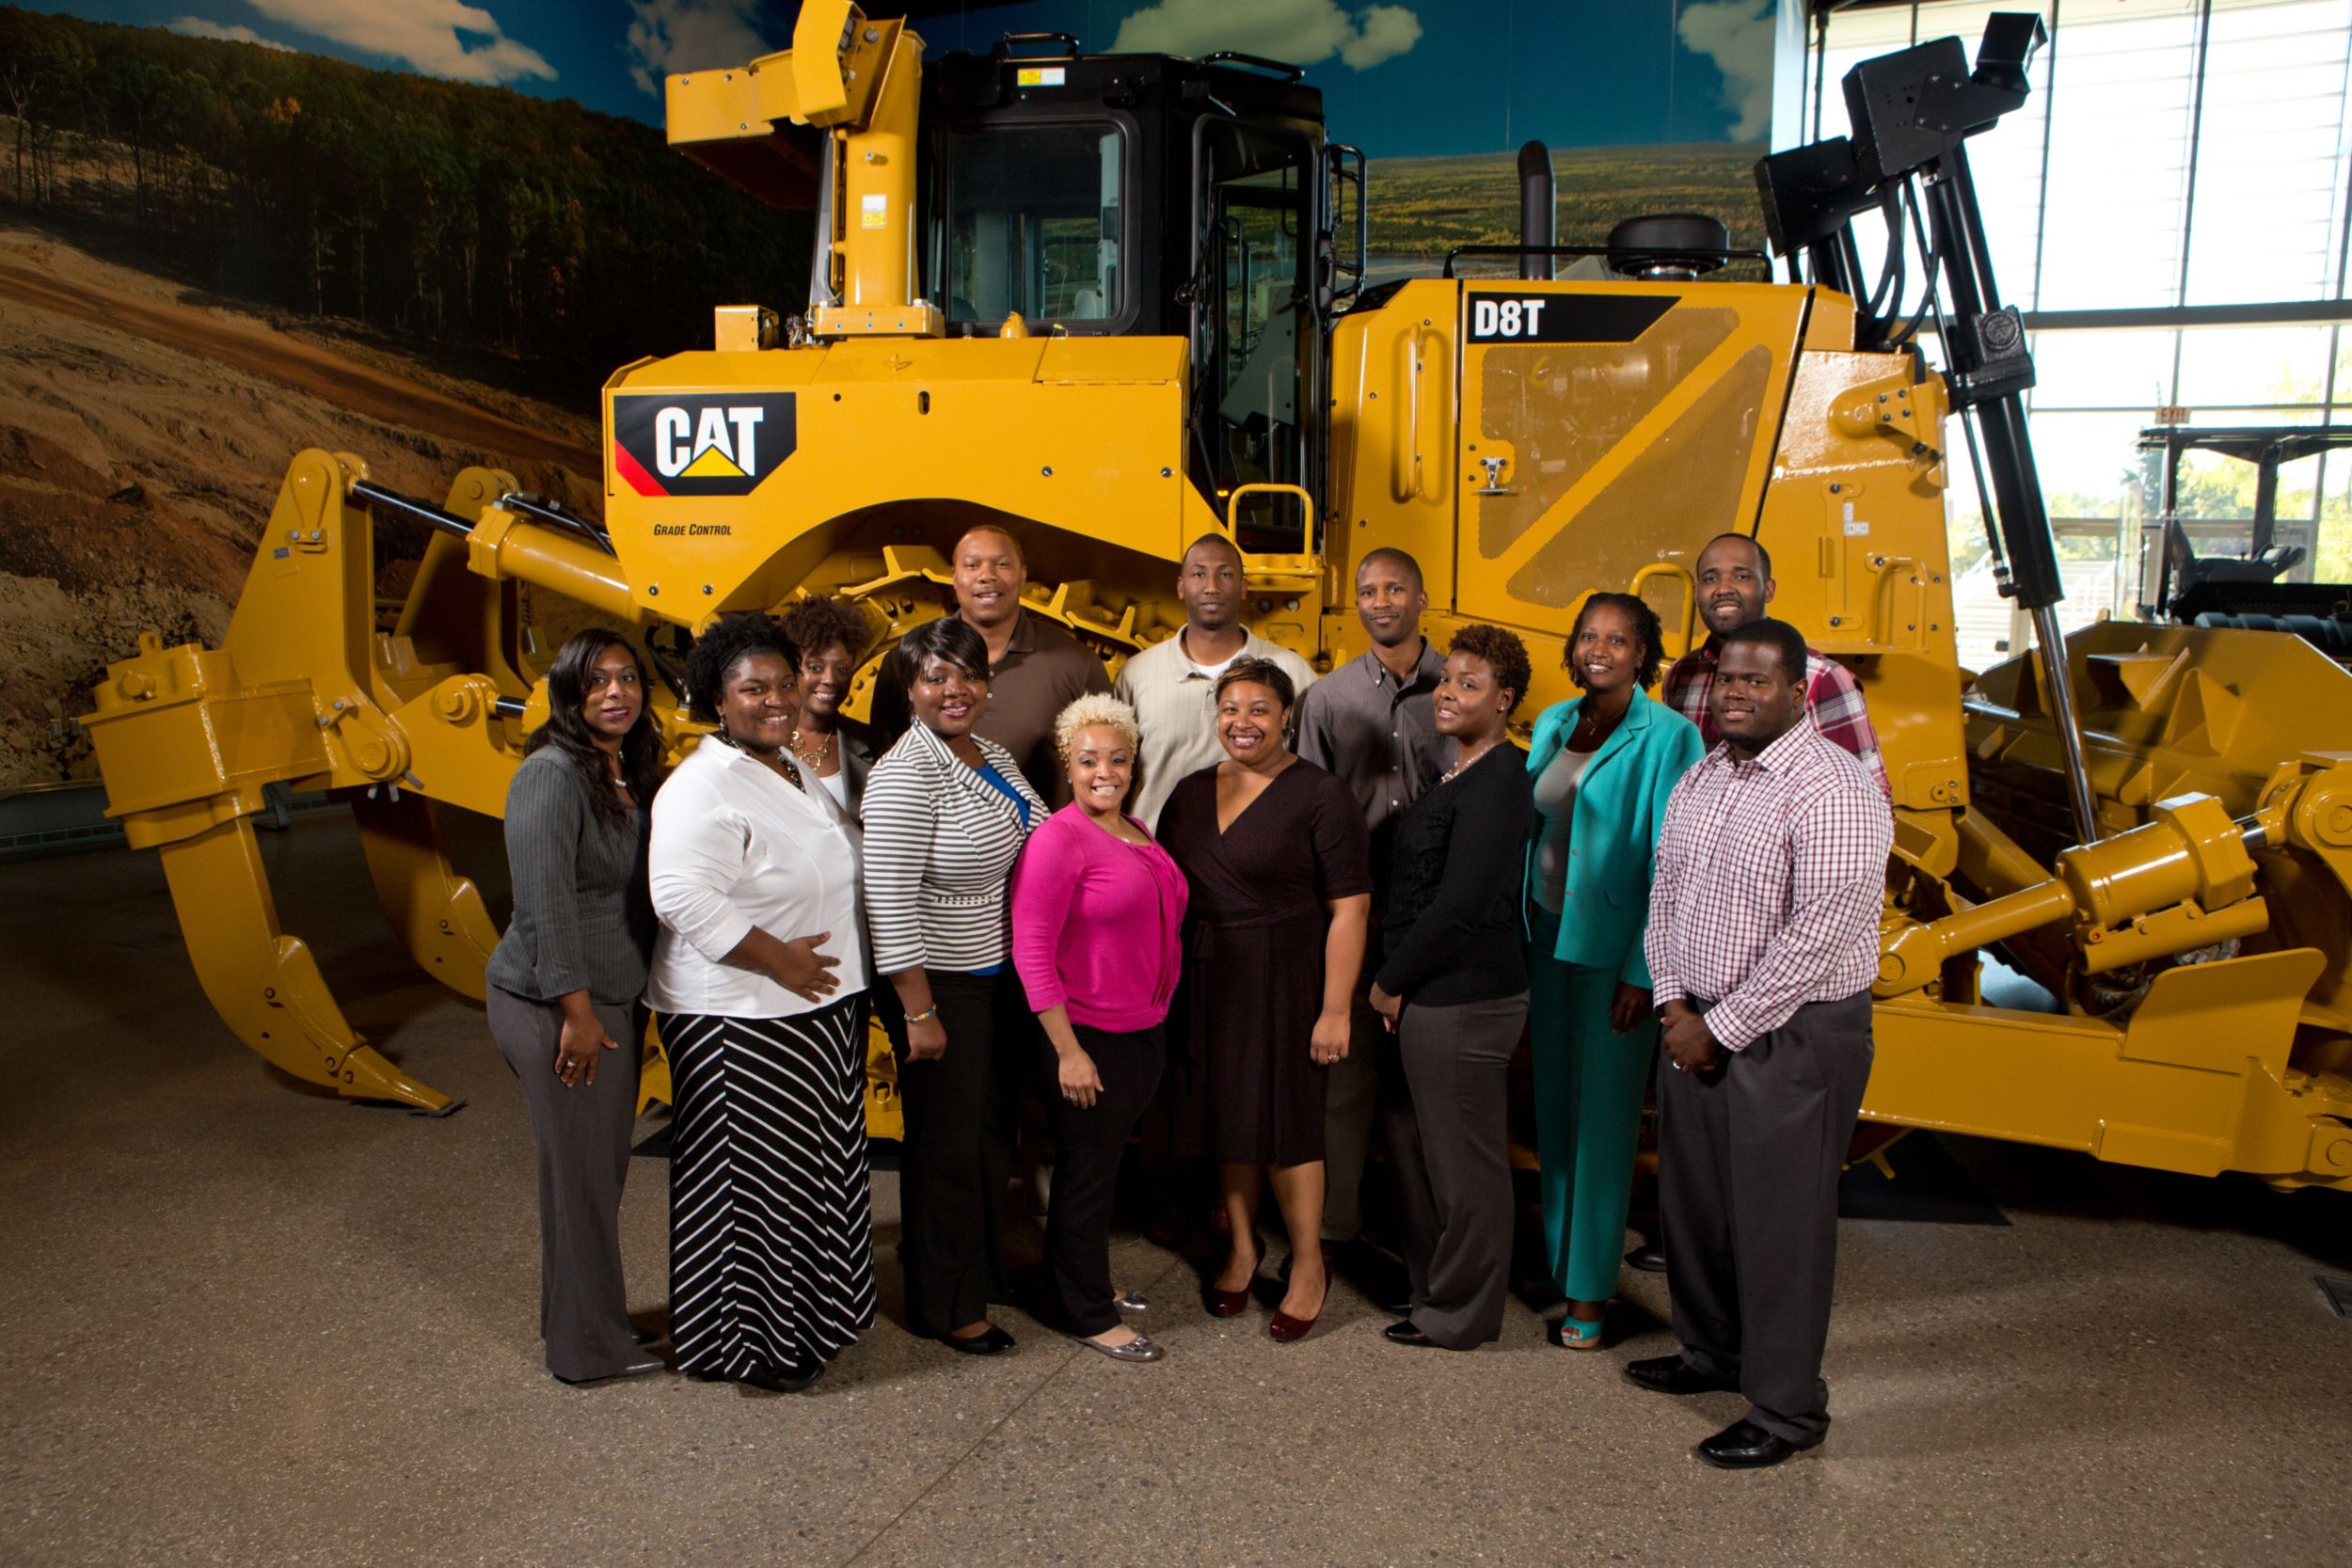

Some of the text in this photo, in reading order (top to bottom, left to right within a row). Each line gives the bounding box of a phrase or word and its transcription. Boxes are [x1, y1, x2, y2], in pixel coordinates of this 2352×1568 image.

[1474, 299, 1546, 337] D8T
[2160, 407, 2187, 423] EXIT
[656, 406, 764, 478] CAT
[653, 523, 732, 536] GRADE CONTROL
